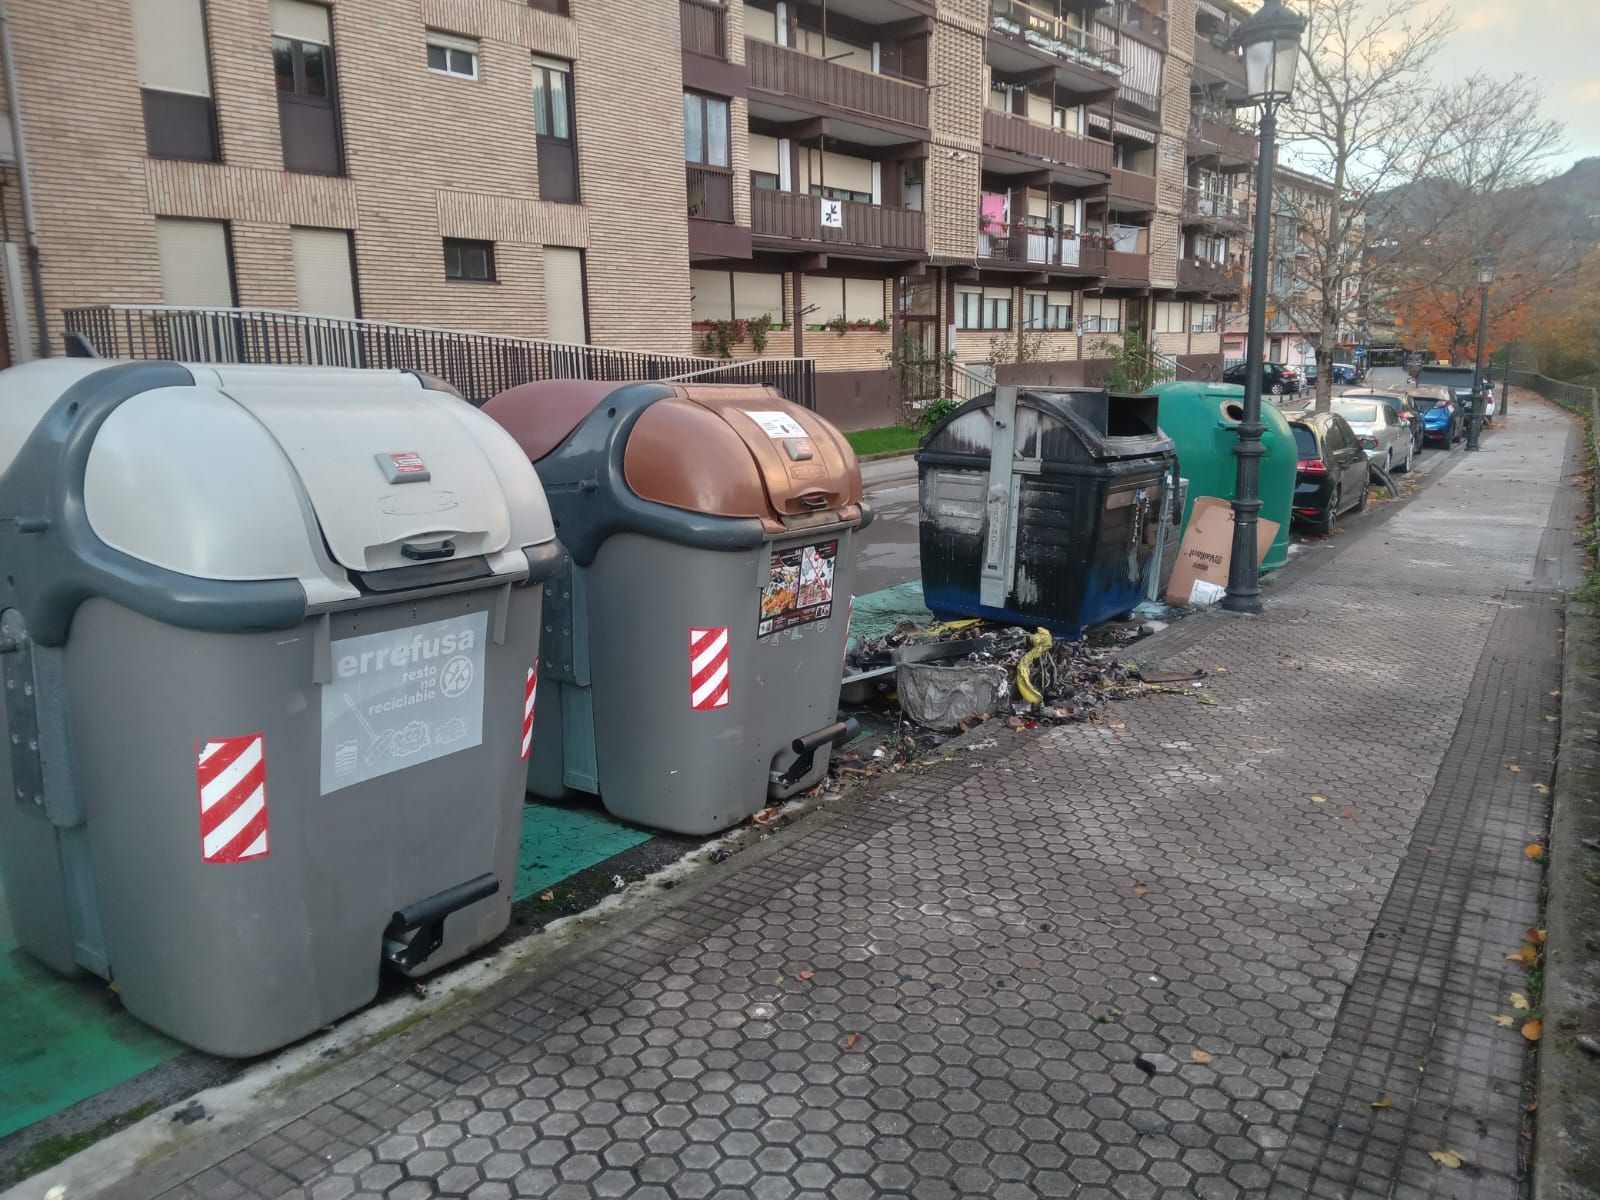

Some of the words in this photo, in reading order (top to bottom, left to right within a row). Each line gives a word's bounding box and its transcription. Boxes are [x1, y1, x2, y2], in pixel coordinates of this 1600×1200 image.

[338, 630, 475, 677] errefusa
[403, 667, 437, 682] resto
[421, 679, 436, 690] no
[368, 689, 435, 716] reciclable
